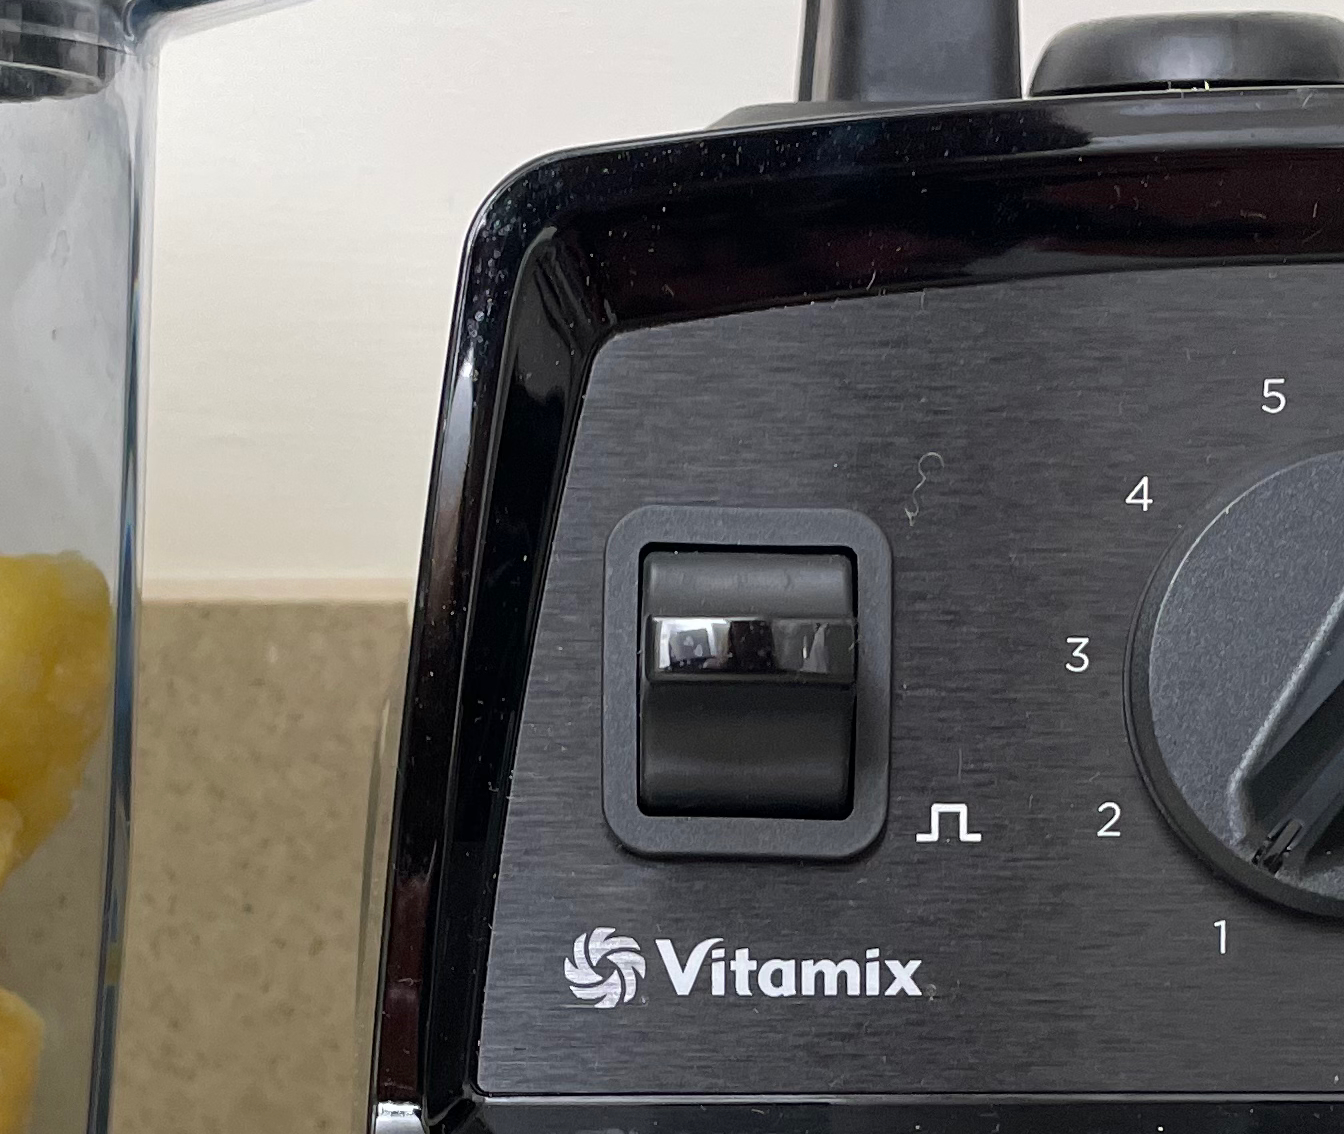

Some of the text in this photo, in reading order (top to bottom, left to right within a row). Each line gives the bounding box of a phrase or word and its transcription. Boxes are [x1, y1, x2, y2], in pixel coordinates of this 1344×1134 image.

[1261, 378, 1286, 413] 5
[1125, 475, 1154, 512] 4
[1065, 637, 1090, 673] 3
[1096, 801, 1121, 837] 2
[1213, 919, 1227, 954] 1
[655, 937, 923, 998] Vitamix
